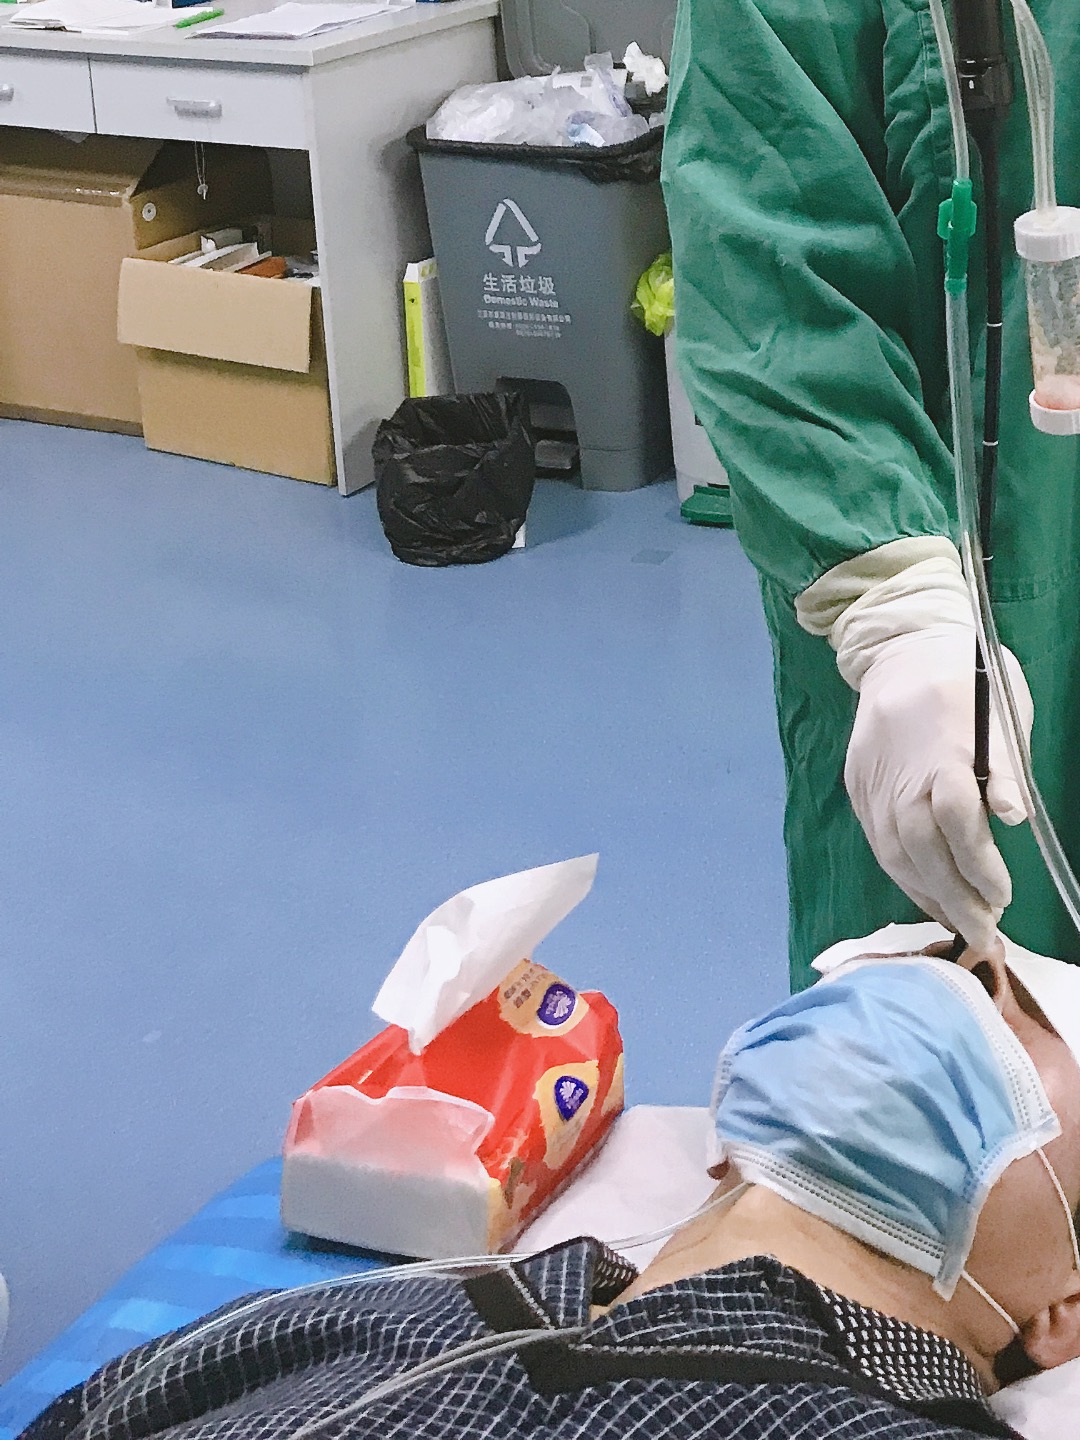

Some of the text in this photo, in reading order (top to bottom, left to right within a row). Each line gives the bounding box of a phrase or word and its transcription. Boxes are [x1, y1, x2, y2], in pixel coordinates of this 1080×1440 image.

[483, 272, 556, 296] 生活垃圾
[483, 294, 559, 309] Domestic Waste
